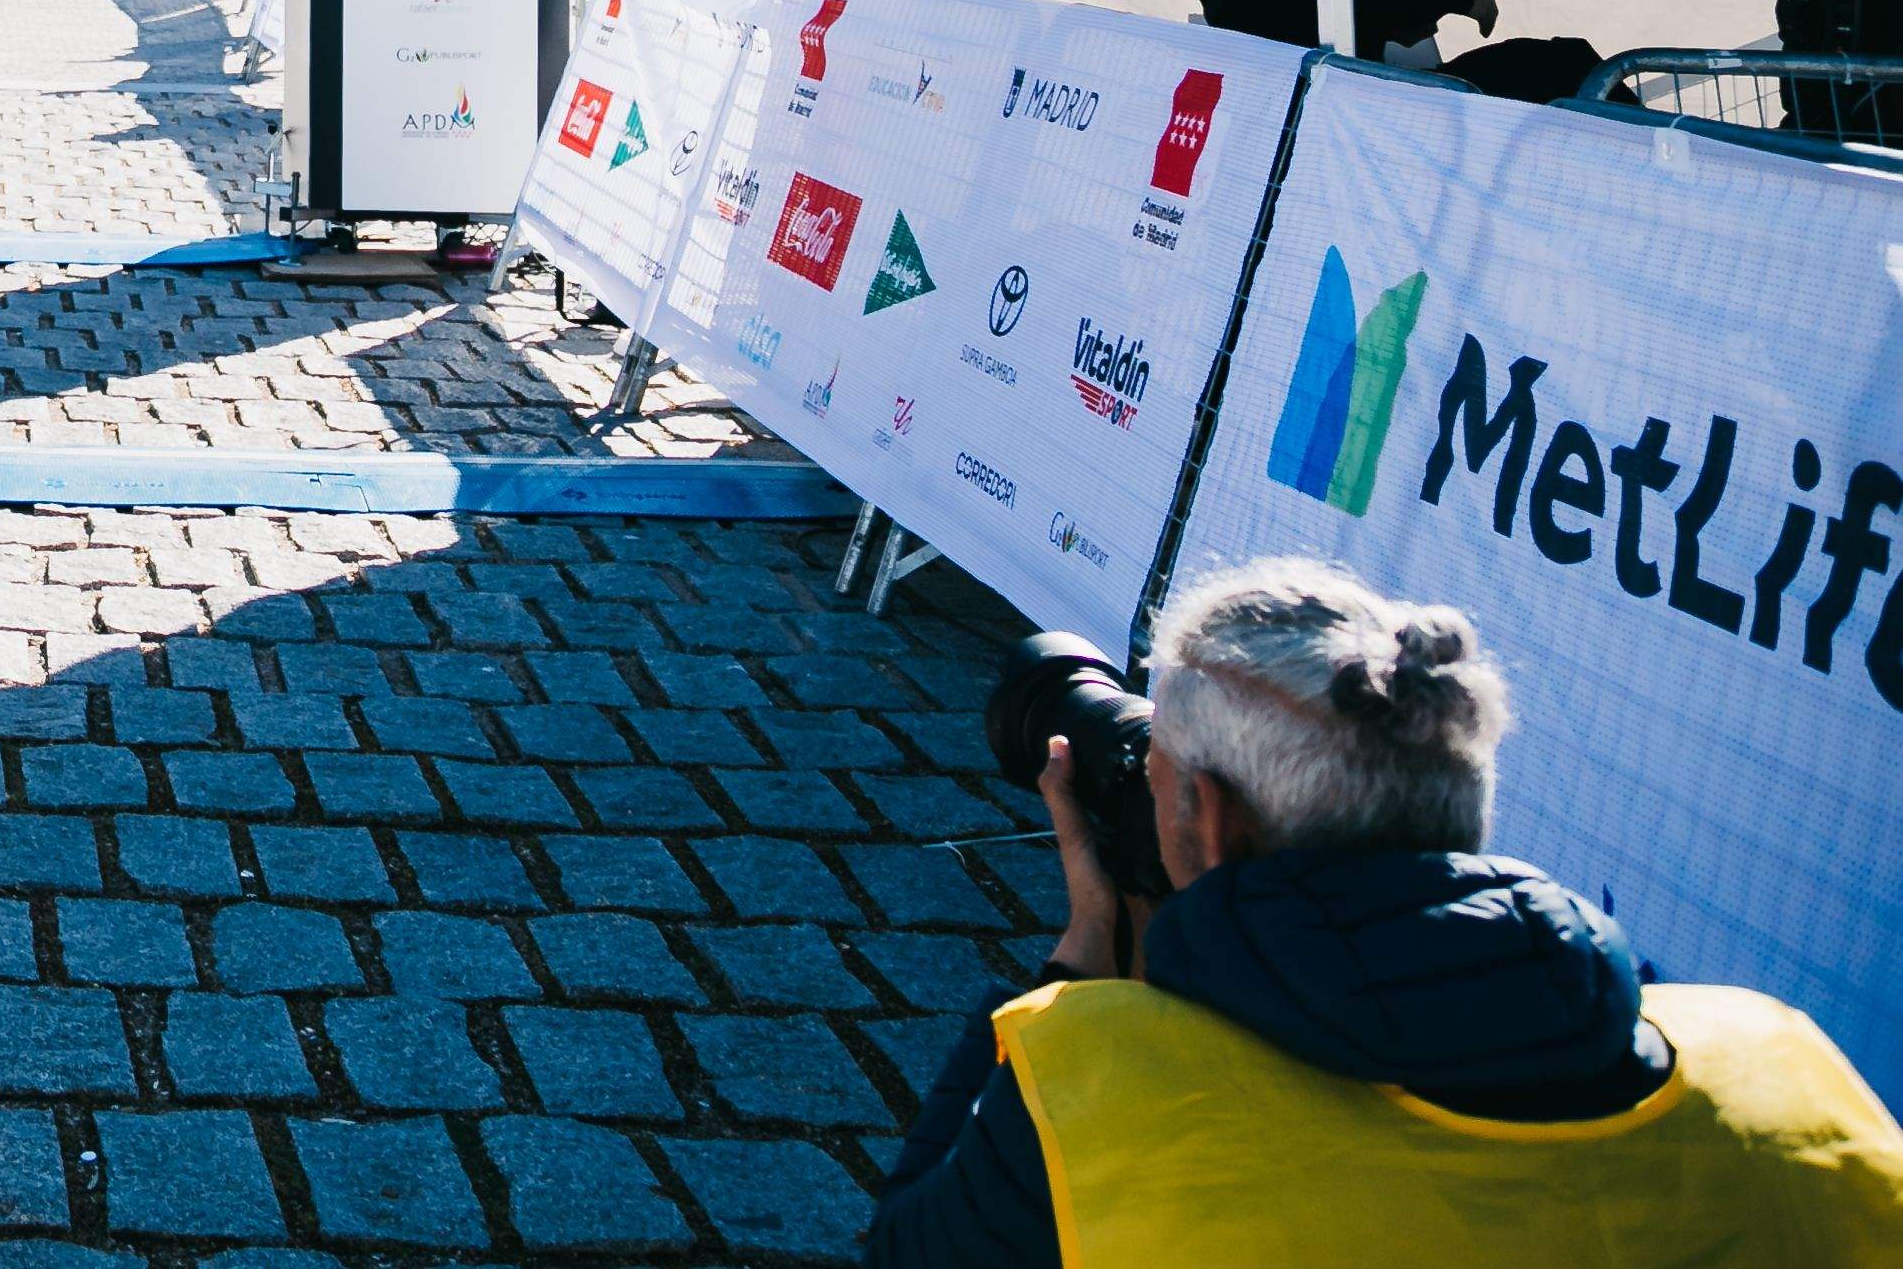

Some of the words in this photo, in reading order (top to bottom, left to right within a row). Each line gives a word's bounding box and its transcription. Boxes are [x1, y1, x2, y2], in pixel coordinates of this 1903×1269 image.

[1024, 78, 1099, 131] MADRID
[960, 344, 983, 370] SUPRA
[984, 356, 1018, 387] GAMBOA
[1073, 317, 1149, 402] Vitaldin
[1098, 391, 1138, 431] SPORT
